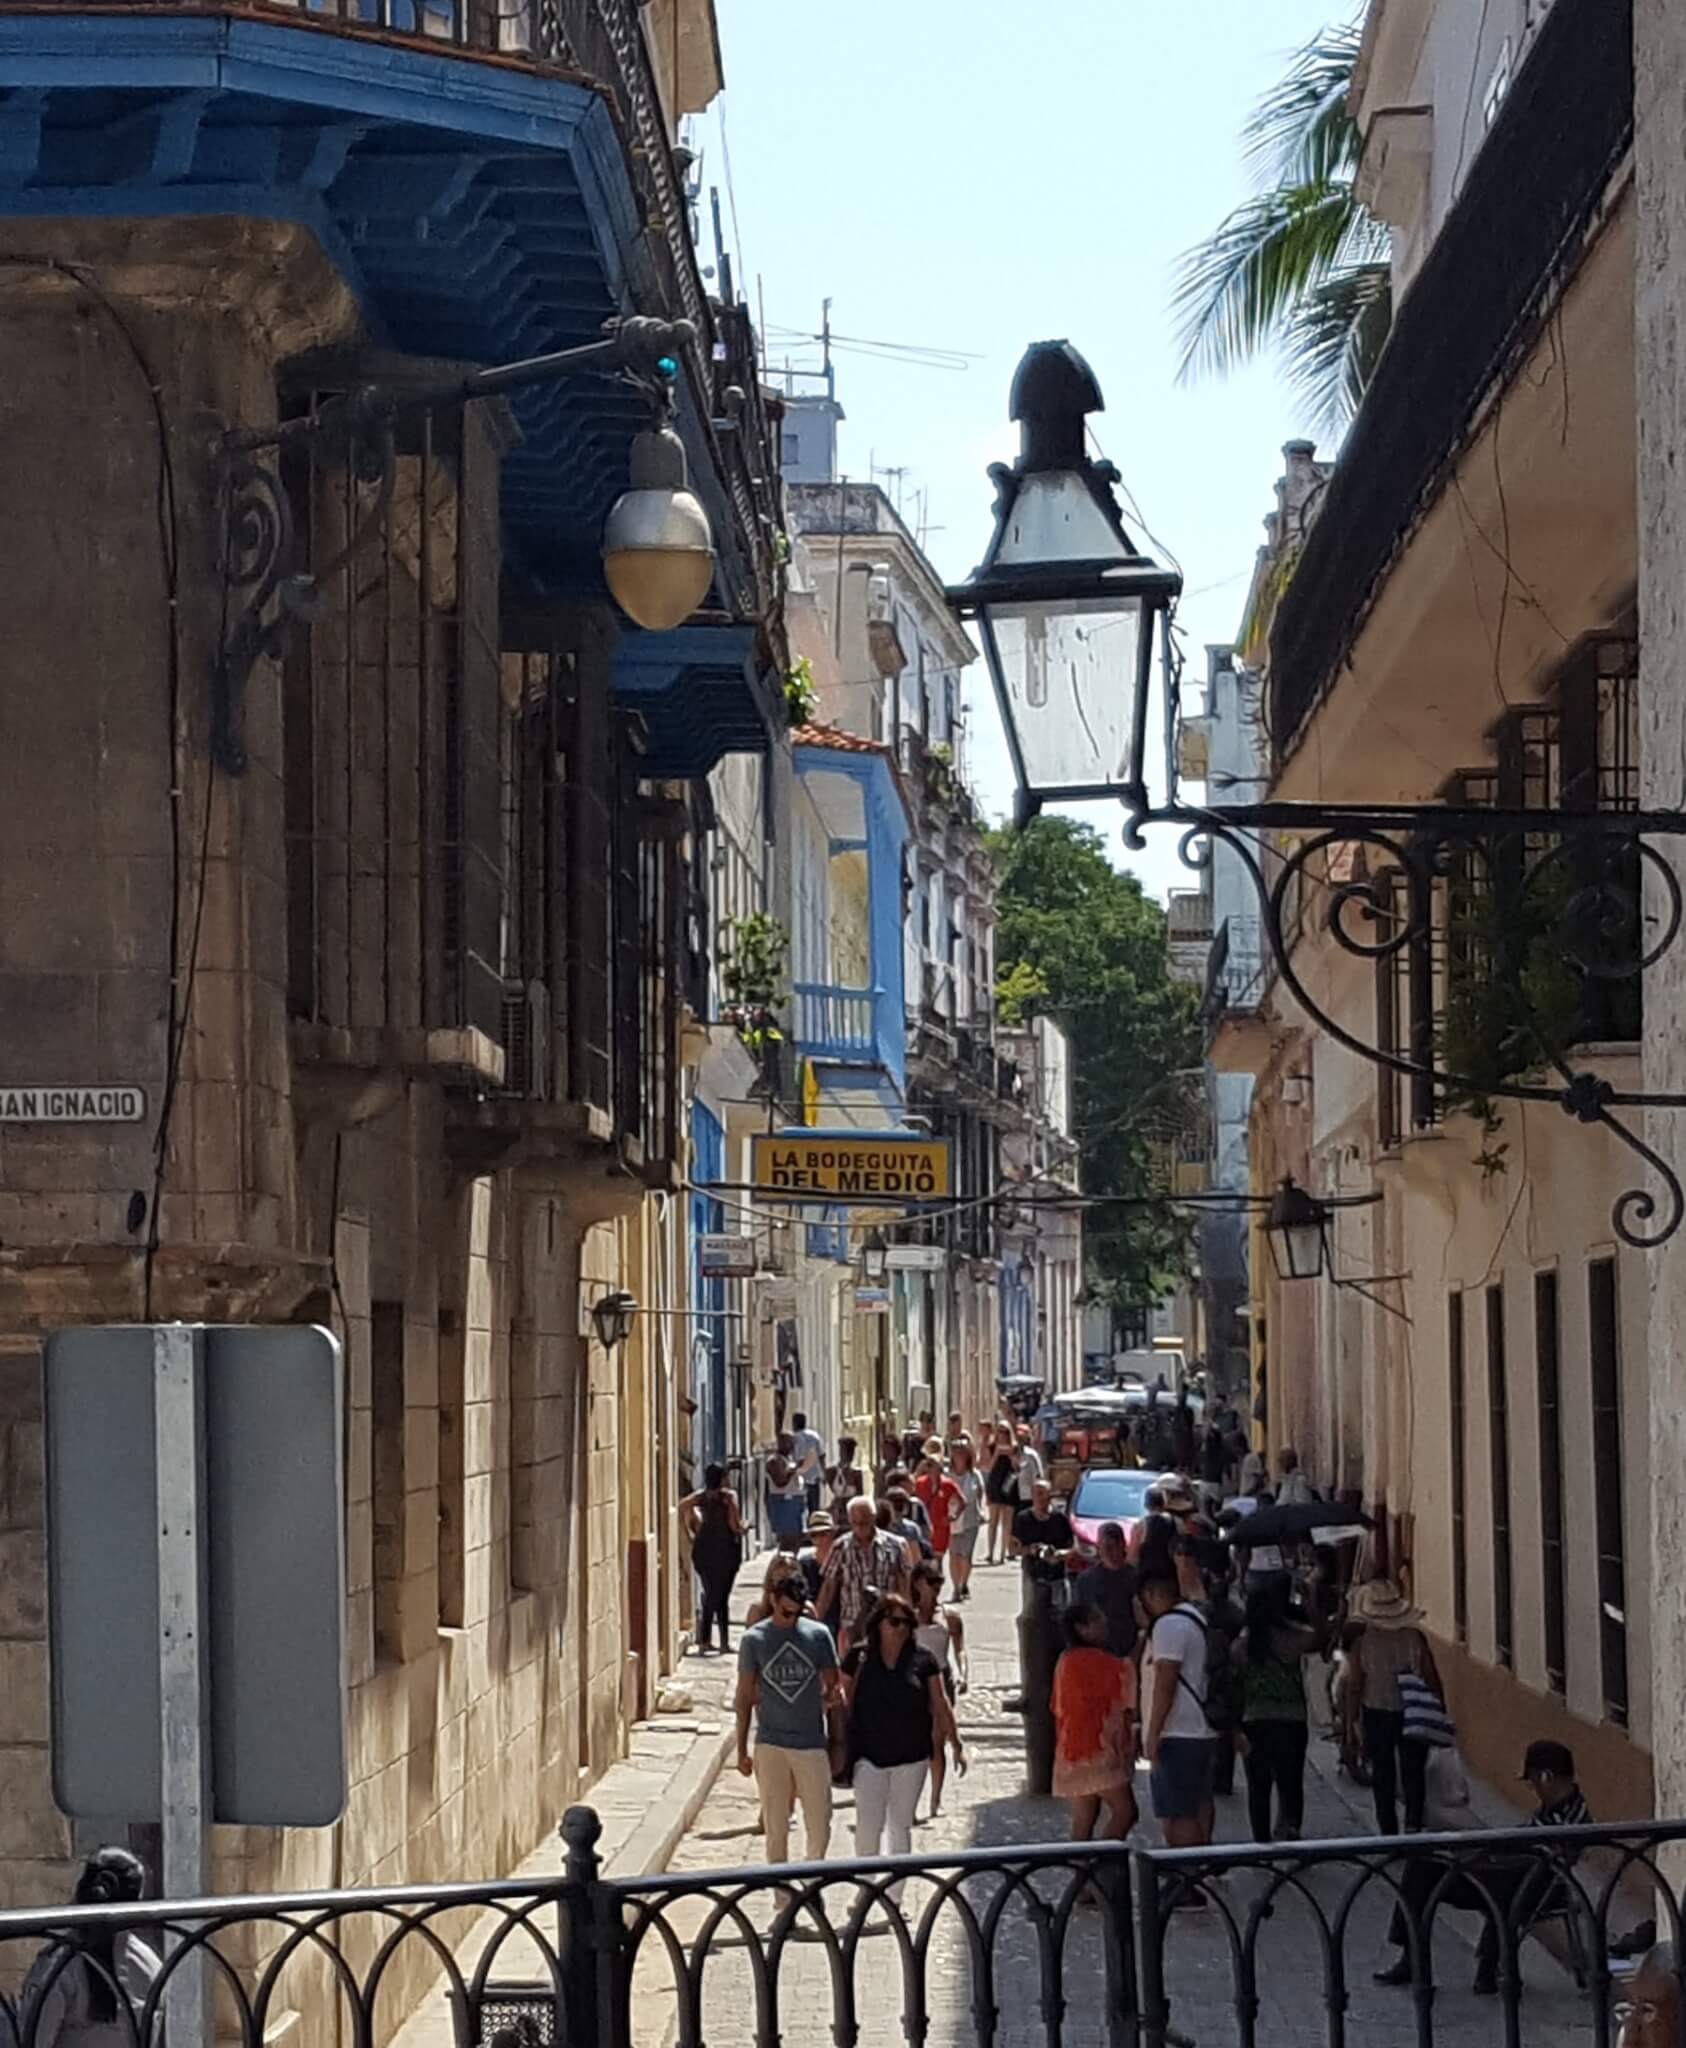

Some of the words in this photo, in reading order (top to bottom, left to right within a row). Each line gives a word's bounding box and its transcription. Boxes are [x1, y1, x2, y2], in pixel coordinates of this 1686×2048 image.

[0, 1092, 36, 1116] AN
[43, 1092, 136, 1116] IGNACIO
[771, 1151, 798, 1168] LA
[806, 1152, 933, 1171] BODEGUITA
[771, 1170, 827, 1189] DEL
[838, 1171, 935, 1193] MEDIO
